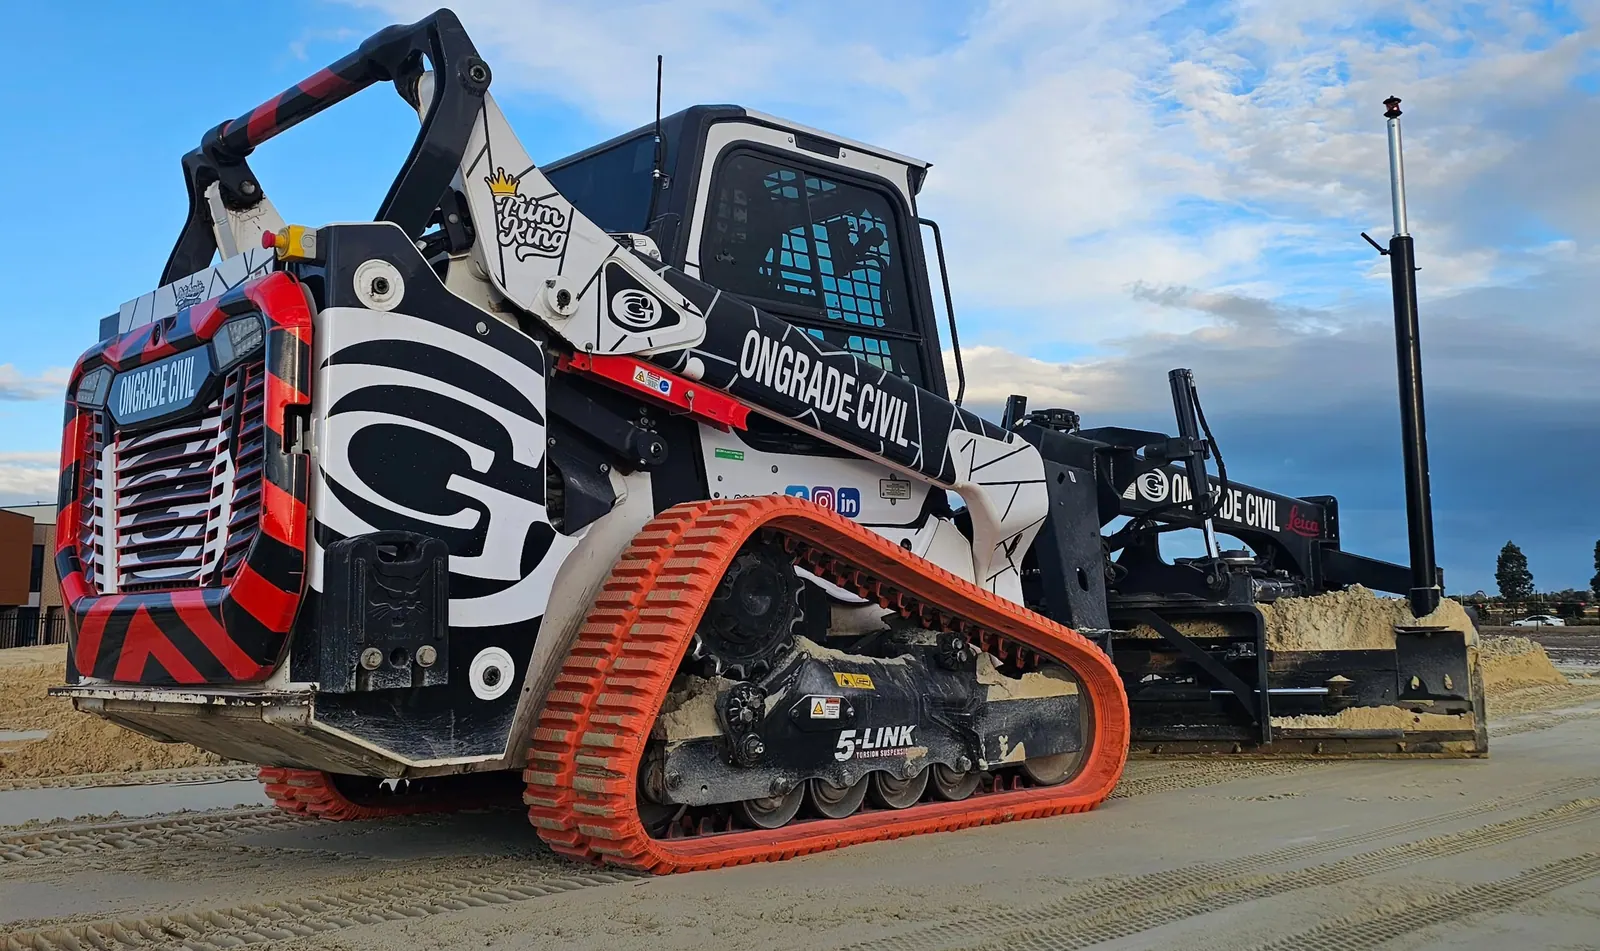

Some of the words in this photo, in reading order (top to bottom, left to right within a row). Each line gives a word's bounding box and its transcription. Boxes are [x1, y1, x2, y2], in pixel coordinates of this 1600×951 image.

[493, 193, 565, 228] Trim
[497, 216, 568, 262] King
[118, 364, 169, 417] ONGRADE
[168, 355, 195, 404] CIVIL
[739, 329, 856, 422] ONGRADE
[856, 382, 909, 448] CIVIL
[1245, 493, 1280, 533] CIVIL
[1285, 504, 1320, 537] Leica
[834, 724, 917, 762] 5-LINK
[856, 750, 879, 759] TORSION
